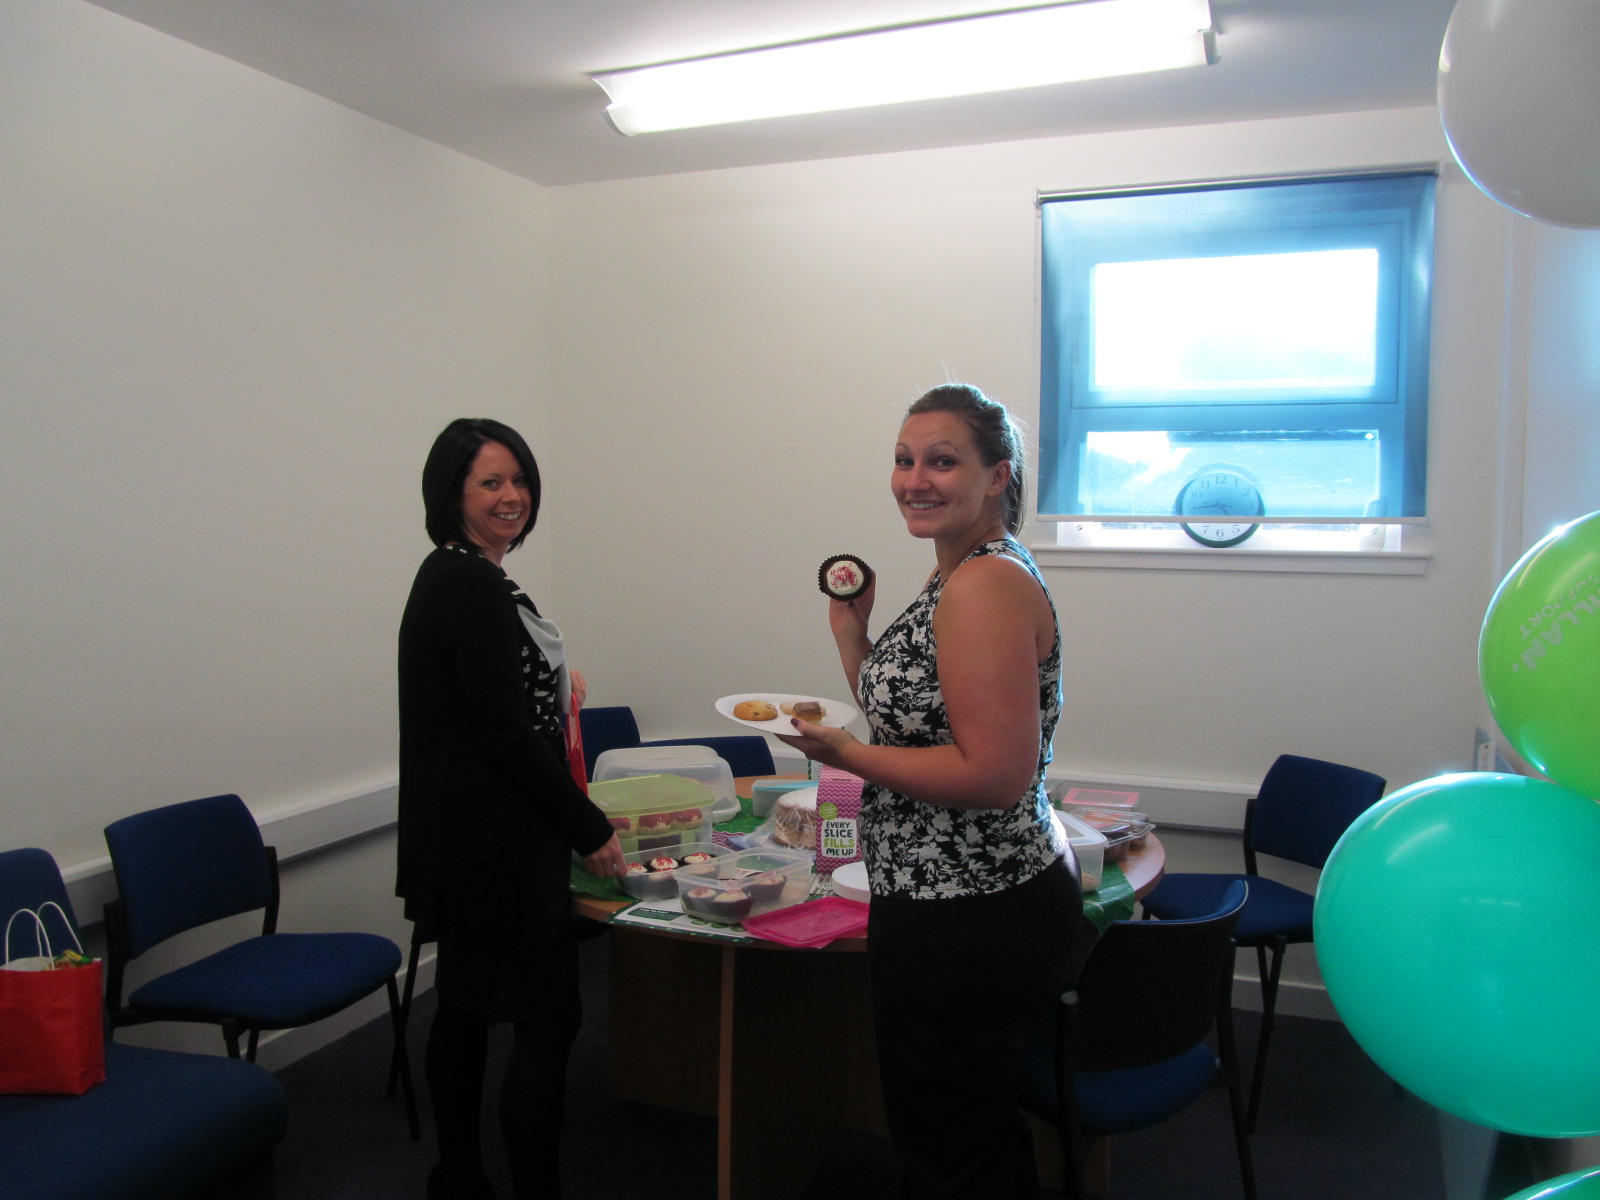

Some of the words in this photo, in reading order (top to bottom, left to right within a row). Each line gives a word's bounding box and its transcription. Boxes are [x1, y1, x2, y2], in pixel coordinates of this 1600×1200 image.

[1215, 475, 1227, 484] 12
[1201, 480, 1210, 489] 11
[1191, 491, 1203, 500] 10
[1243, 487, 1250, 496] 2
[1247, 501, 1255, 510] 3
[1202, 525, 1210, 534] 7
[1216, 529, 1224, 538] 6
[1232, 525, 1240, 533] 5
[826, 821, 850, 829] EVERY
[824, 829, 853, 838] SLICE
[824, 838, 855, 849] FILLS
[826, 848, 840, 856] ME
[841, 848, 854, 856] UP
